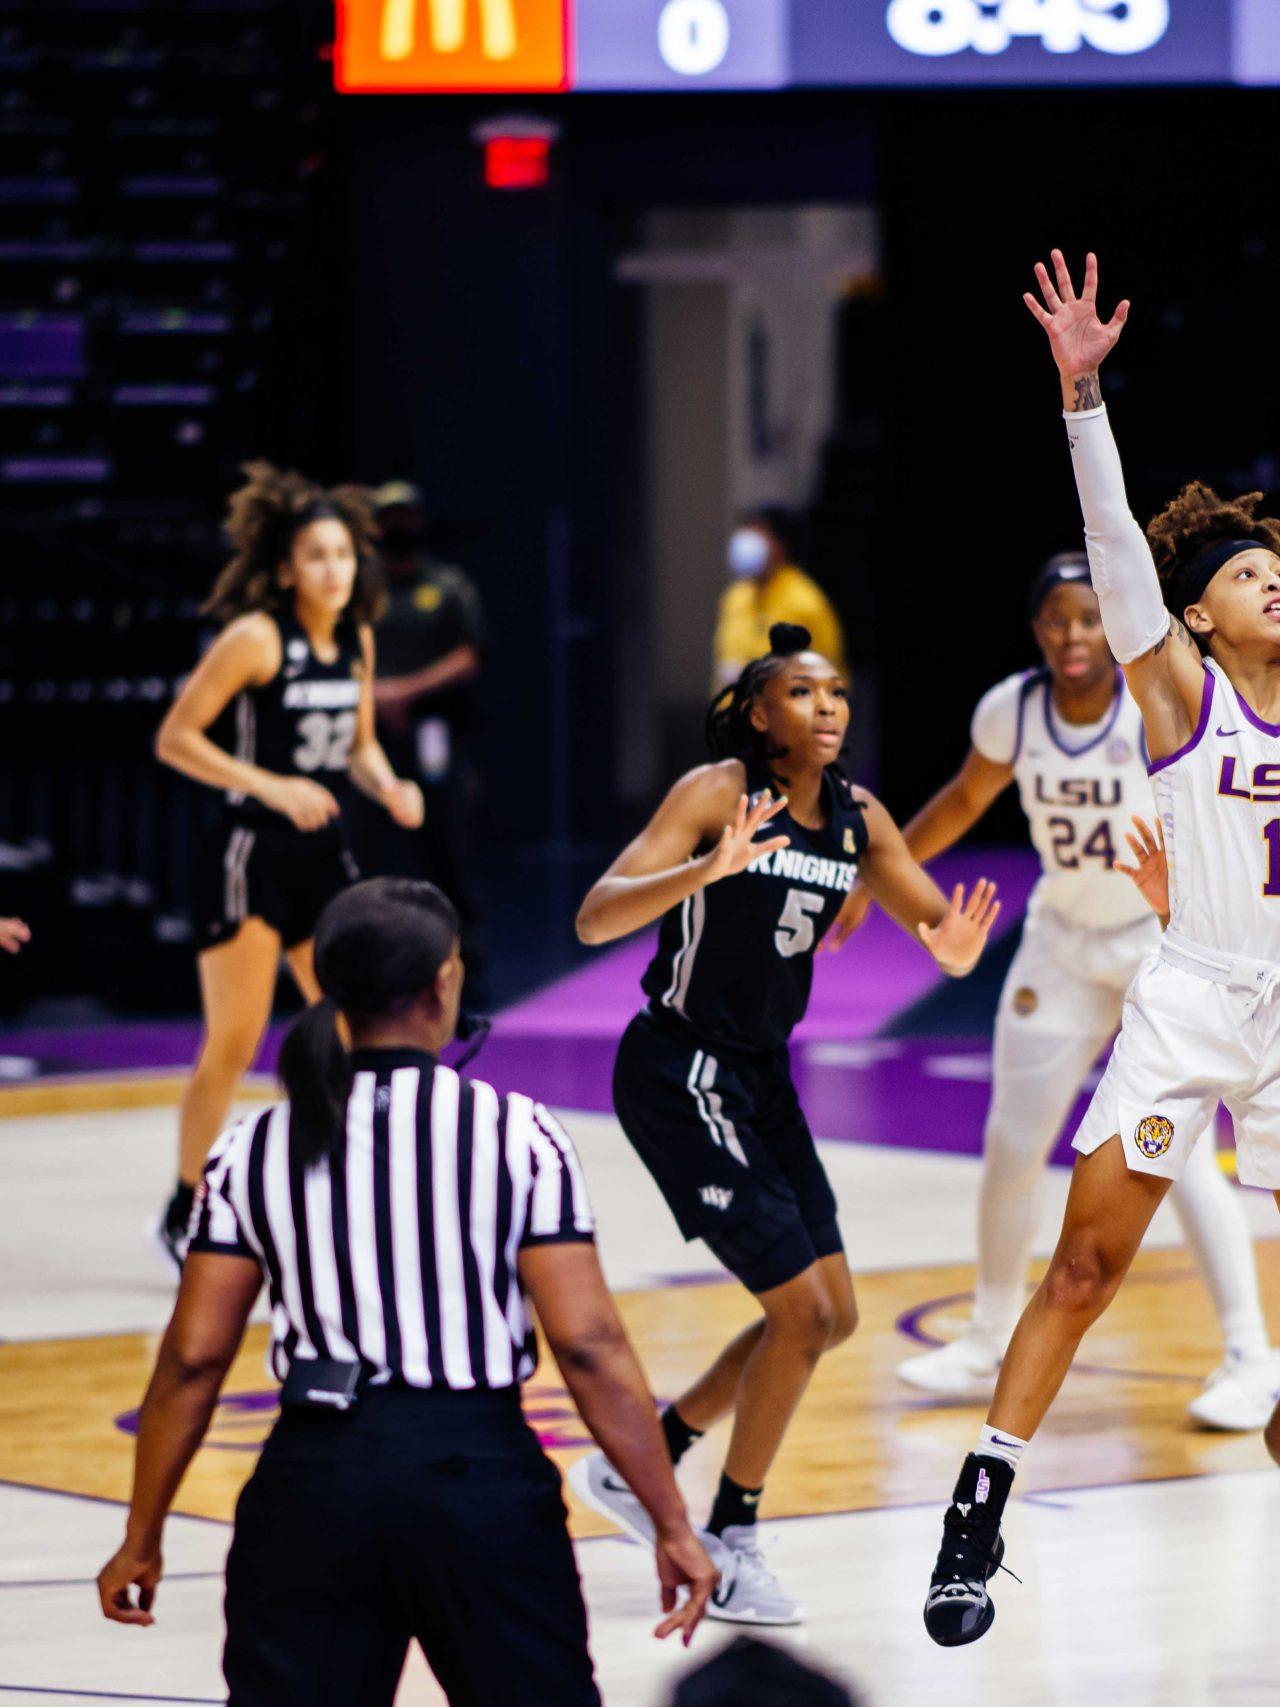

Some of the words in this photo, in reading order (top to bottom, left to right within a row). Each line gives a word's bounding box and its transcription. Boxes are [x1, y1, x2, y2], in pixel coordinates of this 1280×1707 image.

[1035, 774, 1123, 808] LSU
[1047, 816, 1116, 870] 24
[747, 848, 858, 892] KNIGHTS
[774, 887, 826, 959] 5
